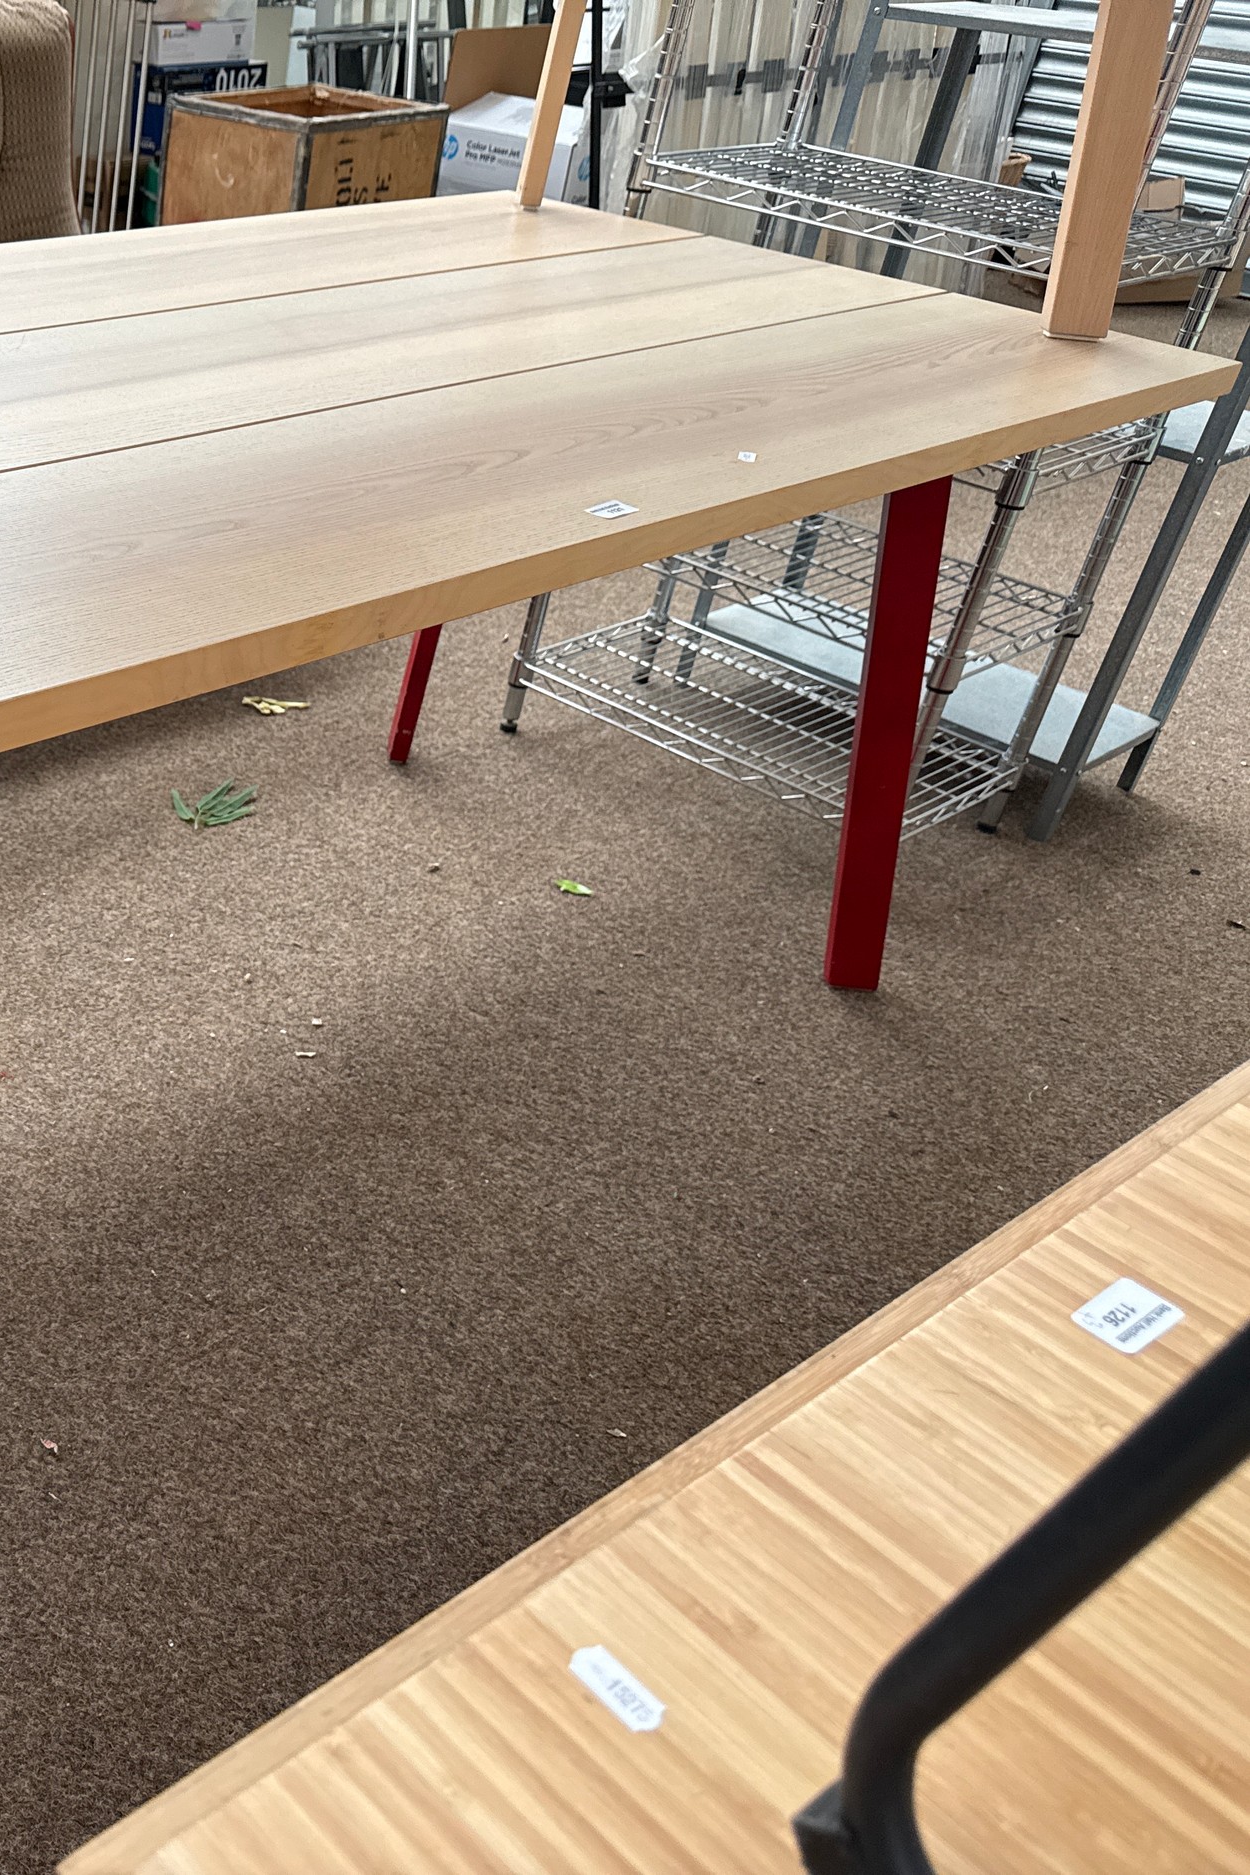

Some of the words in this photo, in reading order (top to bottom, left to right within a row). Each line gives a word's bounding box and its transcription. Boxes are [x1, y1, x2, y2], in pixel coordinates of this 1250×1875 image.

[466, 140, 487, 150] Color
[479, 153, 496, 163] MFP
[1102, 1302, 1137, 1327] 1126
[1117, 1322, 1146, 1343] Auctions
